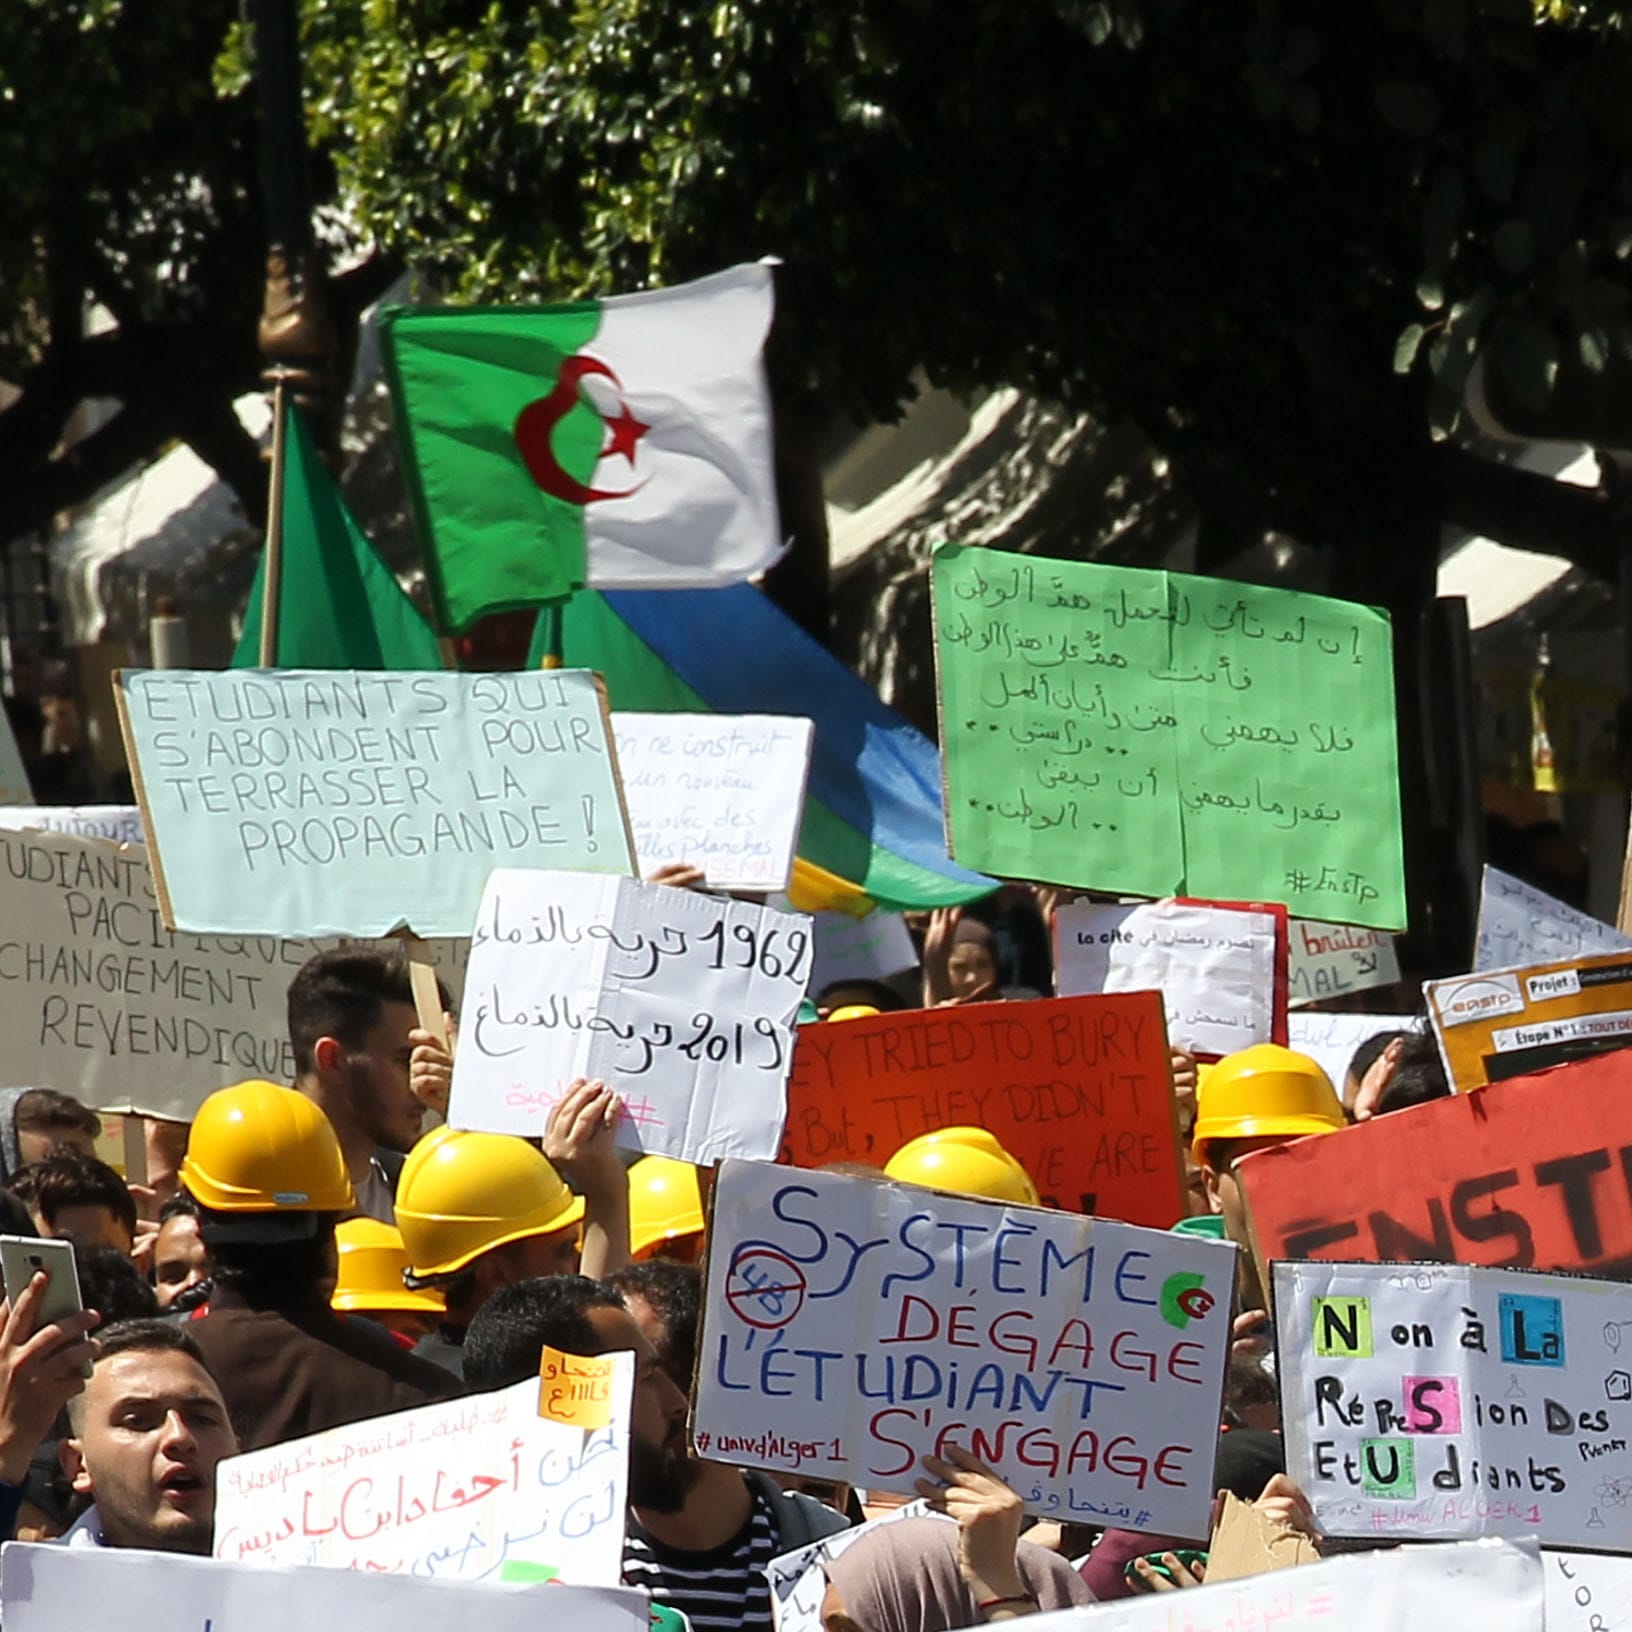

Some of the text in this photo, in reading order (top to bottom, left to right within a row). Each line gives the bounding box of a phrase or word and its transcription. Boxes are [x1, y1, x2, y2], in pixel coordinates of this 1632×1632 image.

[143, 675, 571, 723] ETUDIANTS QUI
[154, 718, 604, 768] S'ABONDENT POUR
[164, 766, 528, 813] TERRASSER LA
[714, 806, 756, 826] des
[239, 806, 568, 870] PROPAGANDE
[0, 943, 262, 1010] CHANGEMENT
[697, 921, 807, 985] 1962
[680, 1013, 782, 1070] 2019
[852, 1011, 1146, 1079] TRIED TO BURY
[1089, 1134, 1160, 1180] ARE
[880, 1288, 1205, 1384] DÉGAGE
[868, 1407, 1194, 1490] S'ENGAGE
[560, 1480, 615, 1538] لن
